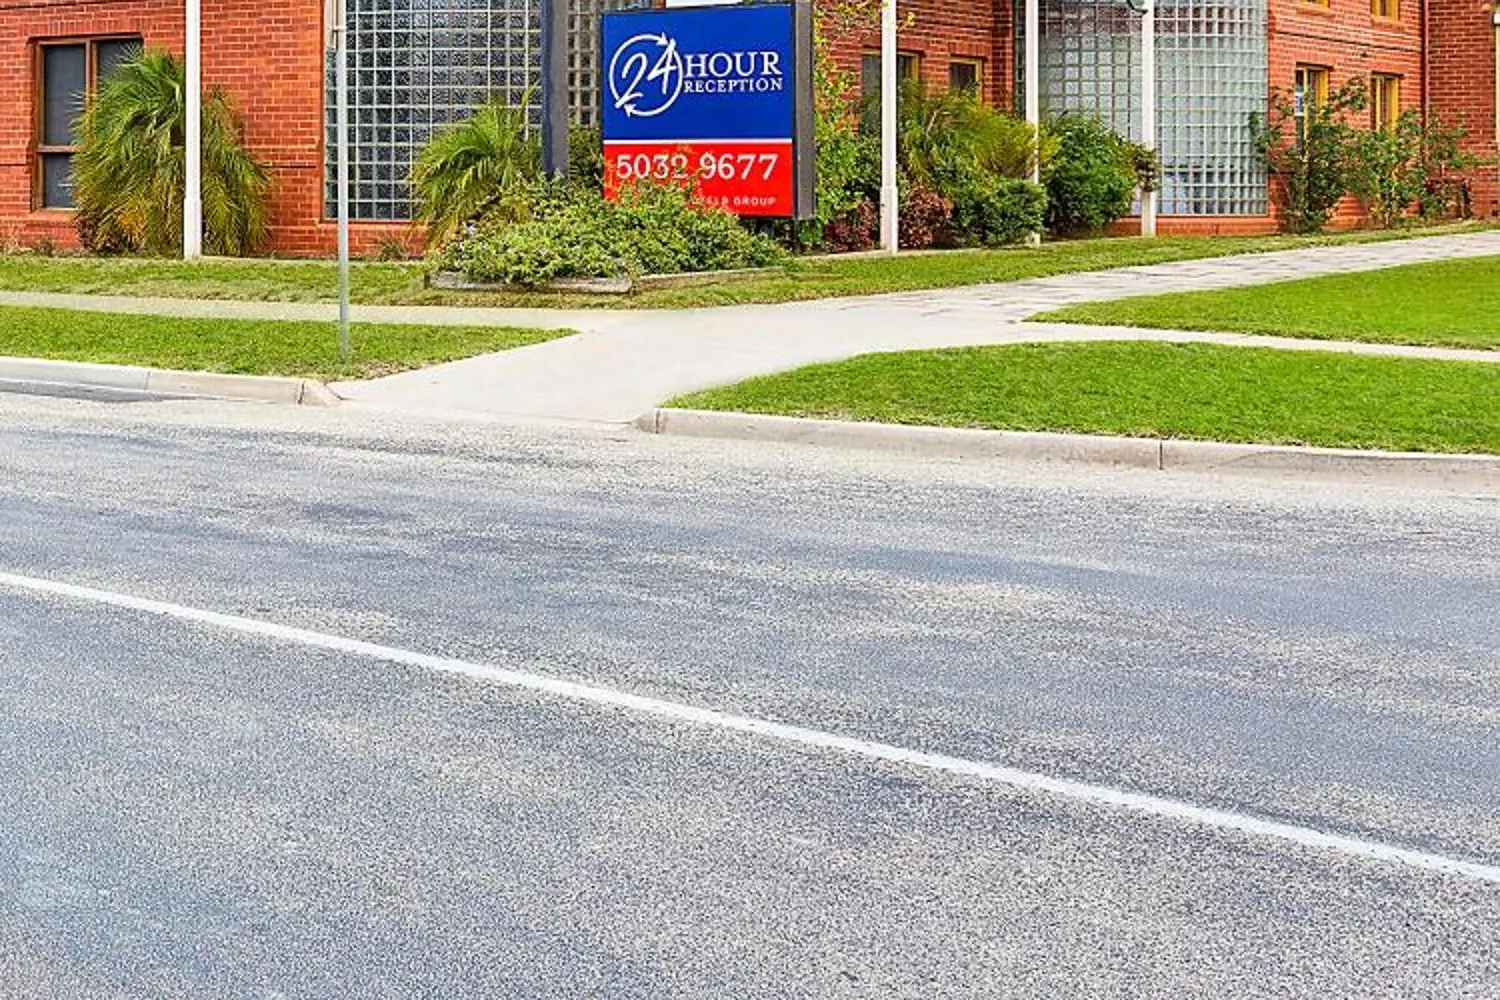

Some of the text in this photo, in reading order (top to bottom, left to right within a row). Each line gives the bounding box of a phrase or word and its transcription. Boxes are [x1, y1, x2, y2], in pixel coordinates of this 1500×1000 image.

[683, 51, 784, 78] HOUR
[684, 77, 784, 94] RECEPTION
[616, 152, 779, 181] 5032 9677
[733, 195, 777, 207] GROUP
